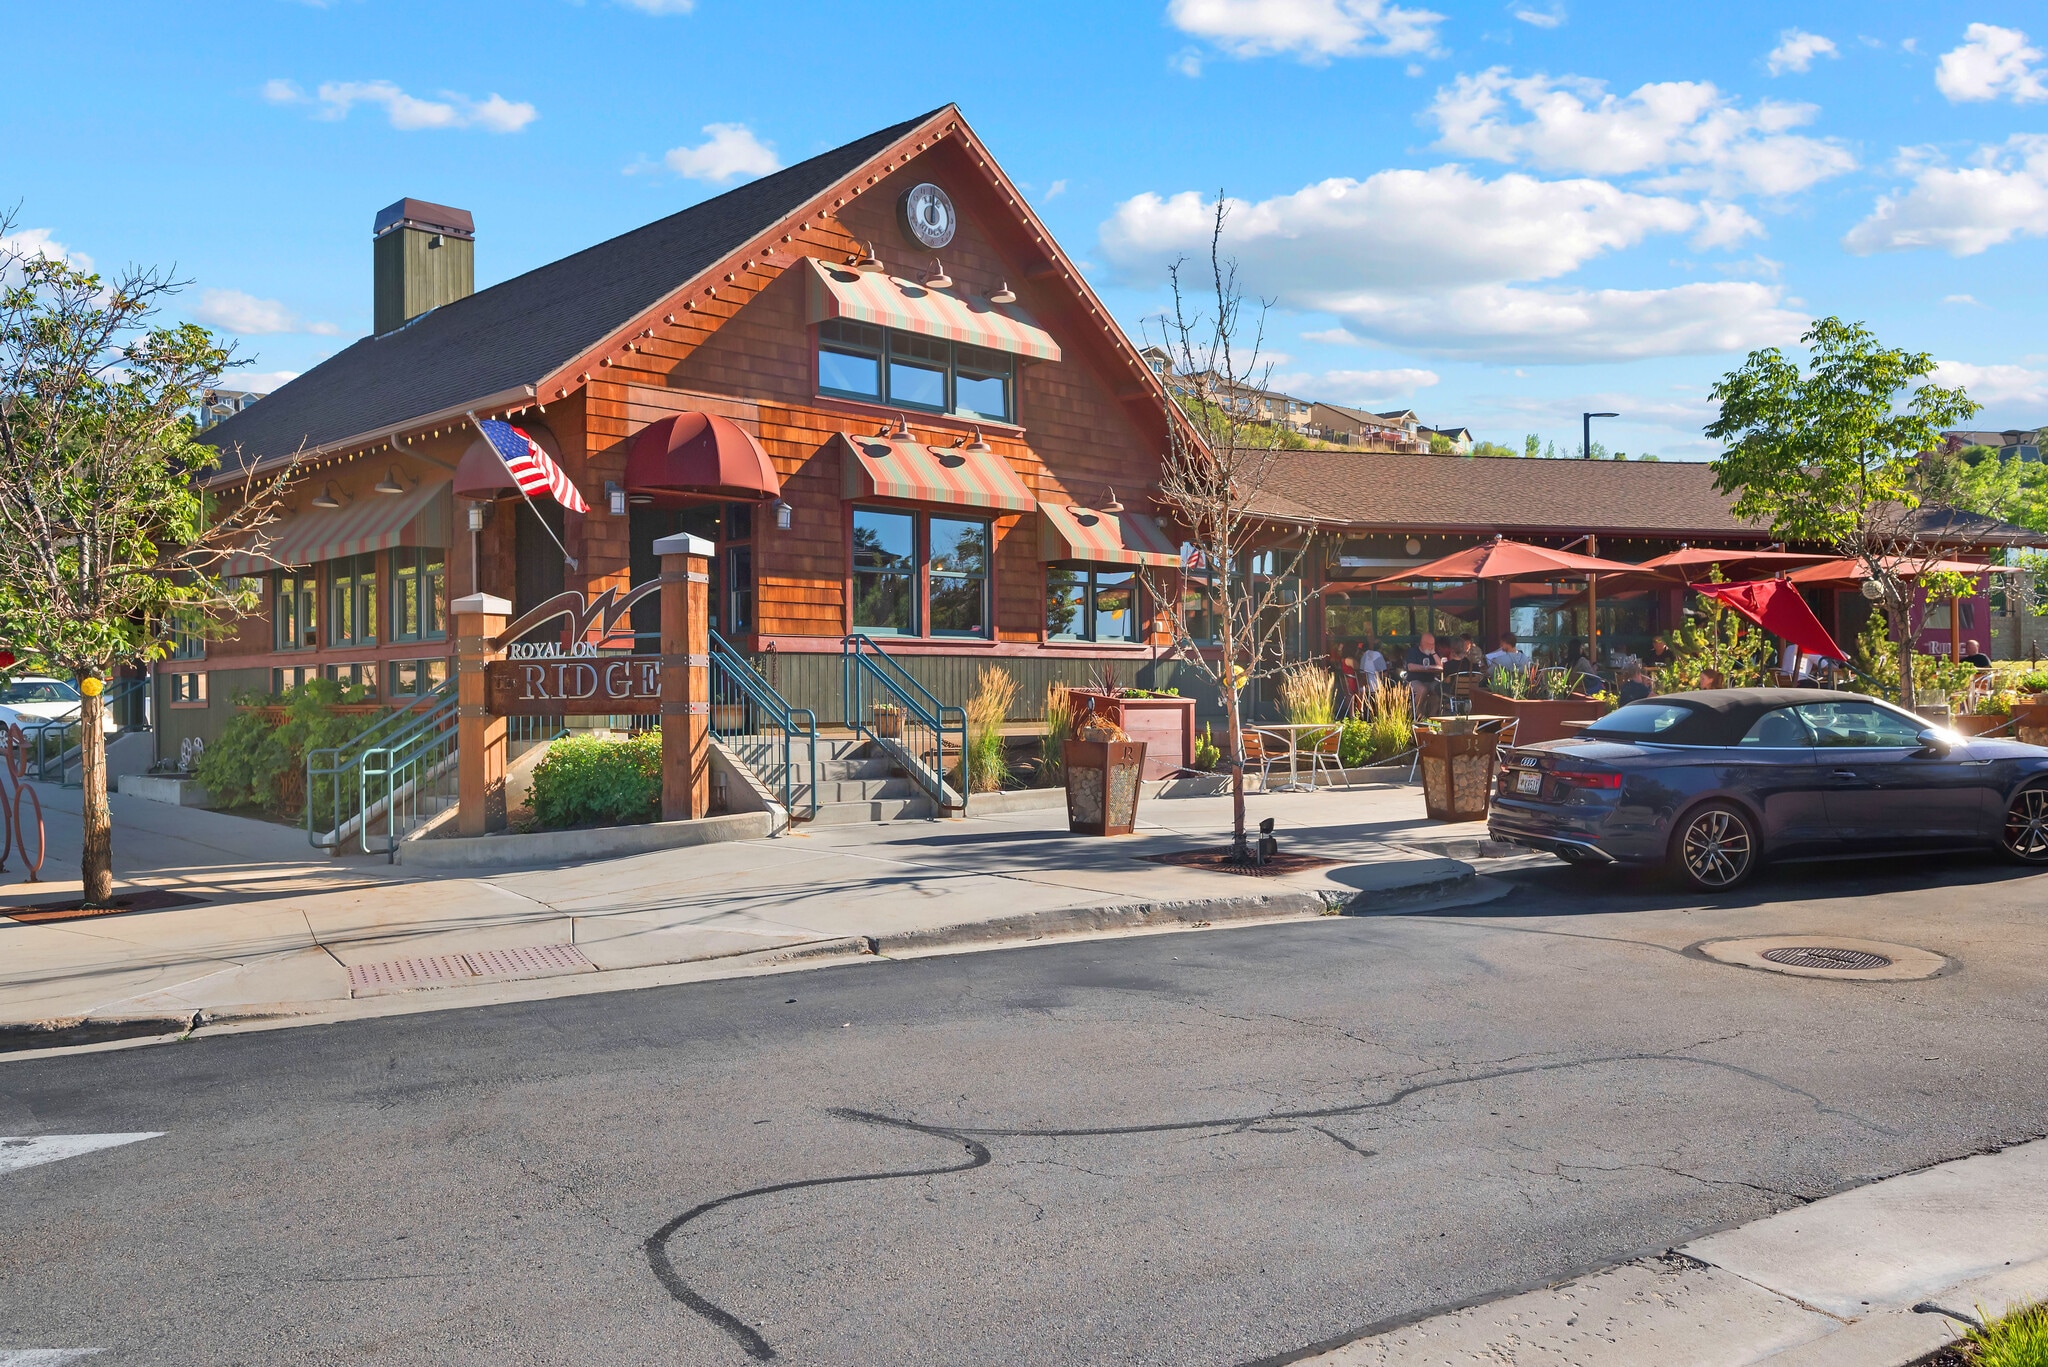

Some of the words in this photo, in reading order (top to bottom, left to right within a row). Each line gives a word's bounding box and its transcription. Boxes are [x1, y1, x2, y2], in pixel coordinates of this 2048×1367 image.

[509, 642, 566, 660] ROYAL
[573, 641, 599, 658] ON
[519, 661, 662, 700] RIDGE
